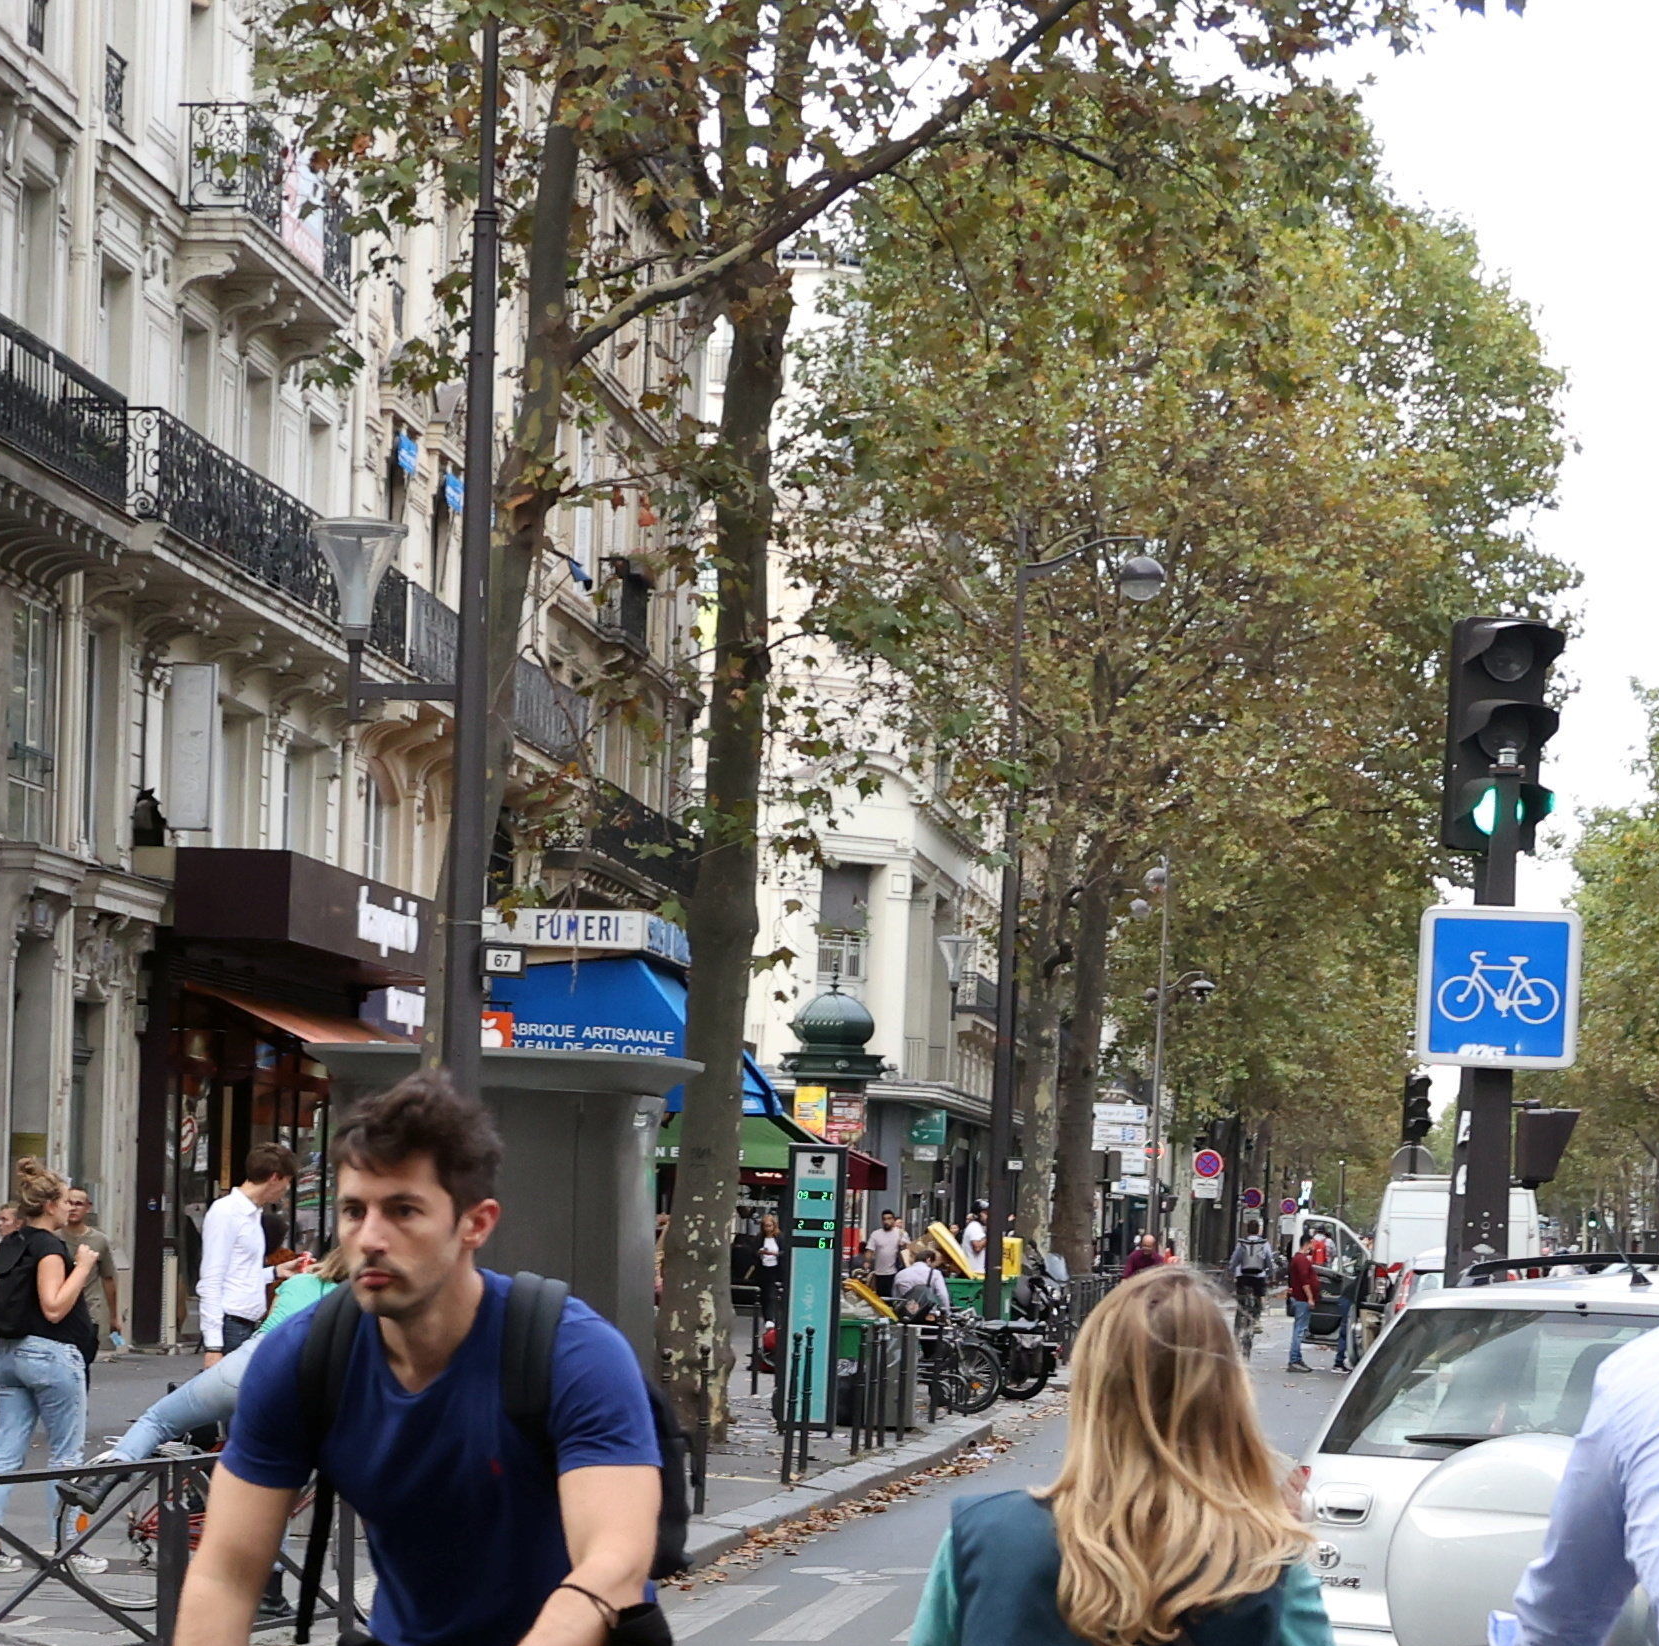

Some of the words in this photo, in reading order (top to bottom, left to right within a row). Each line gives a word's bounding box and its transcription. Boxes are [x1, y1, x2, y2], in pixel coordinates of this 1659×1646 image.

[493, 954, 512, 968] 67
[511, 1022, 576, 1039] ABRIQUE
[582, 1026, 676, 1045] ARTISANALE
